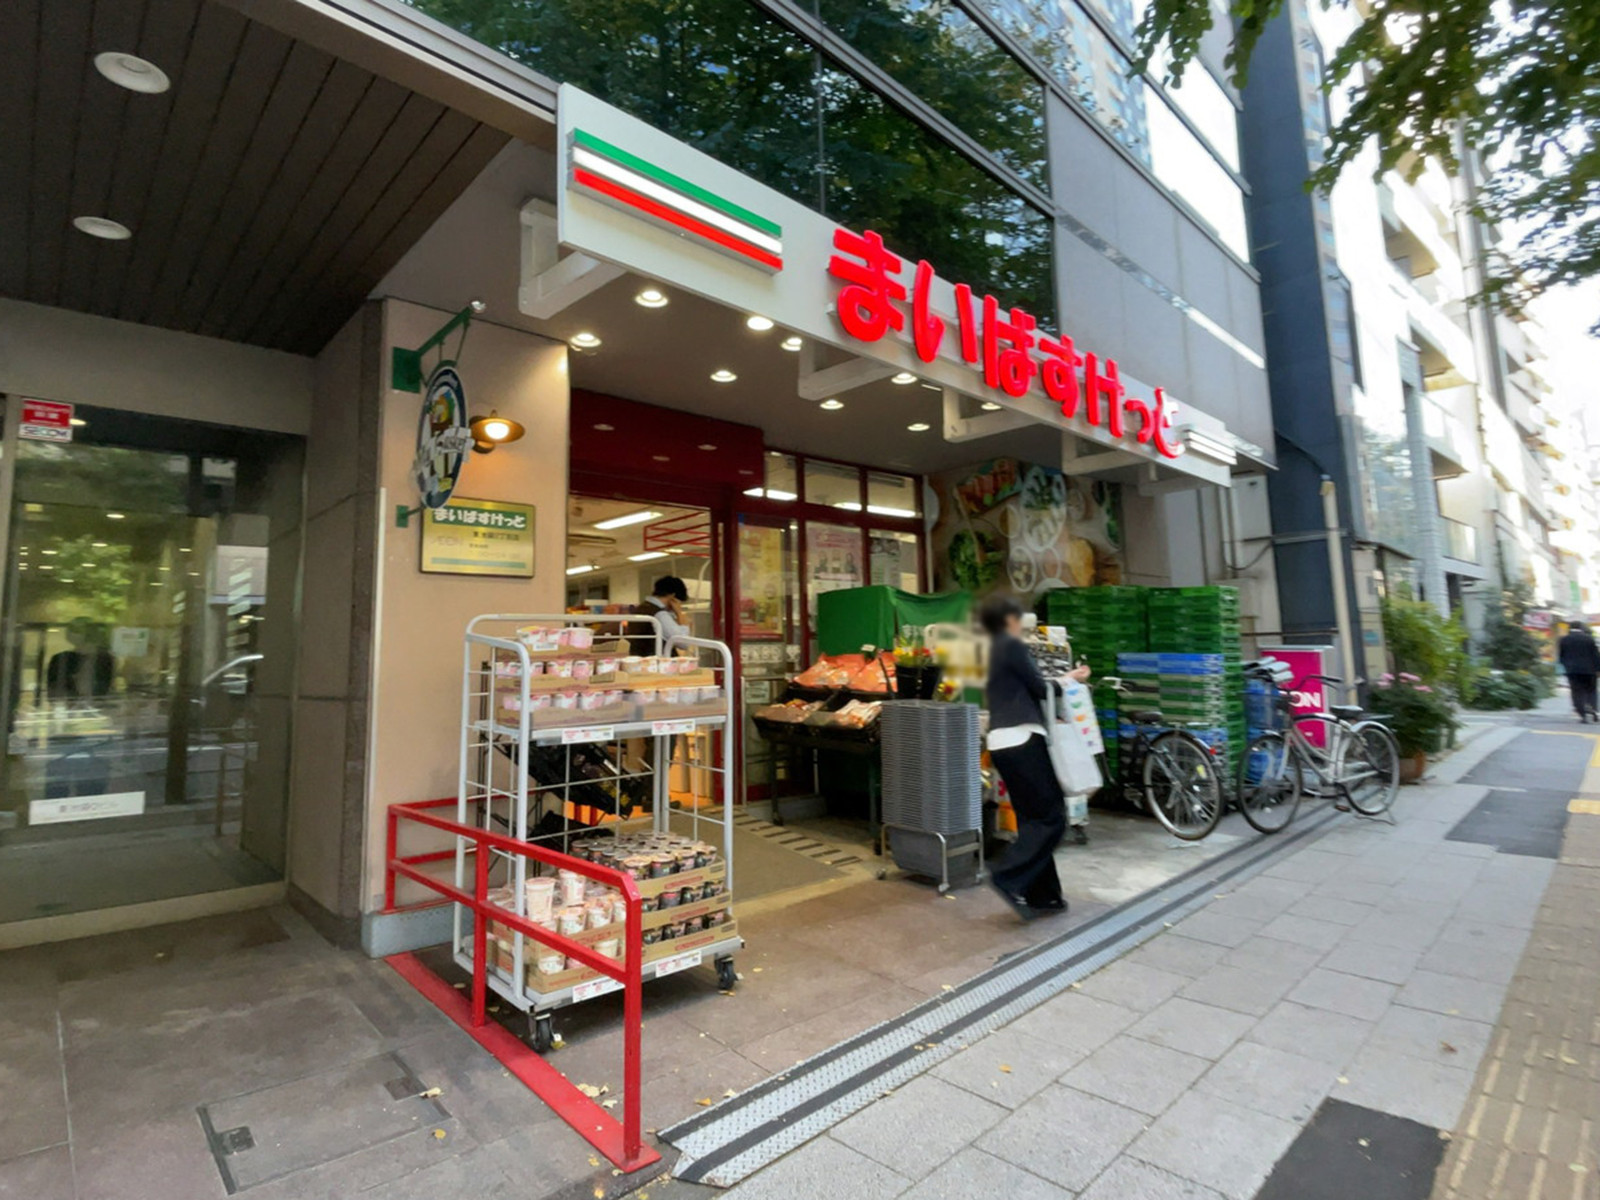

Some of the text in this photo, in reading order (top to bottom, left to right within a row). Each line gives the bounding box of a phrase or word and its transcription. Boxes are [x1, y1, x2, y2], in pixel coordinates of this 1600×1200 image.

[829, 228, 1186, 459] まいばすけっと
[23, 426, 68, 438] SECOM
[434, 508, 526, 528] まいばすけっと
